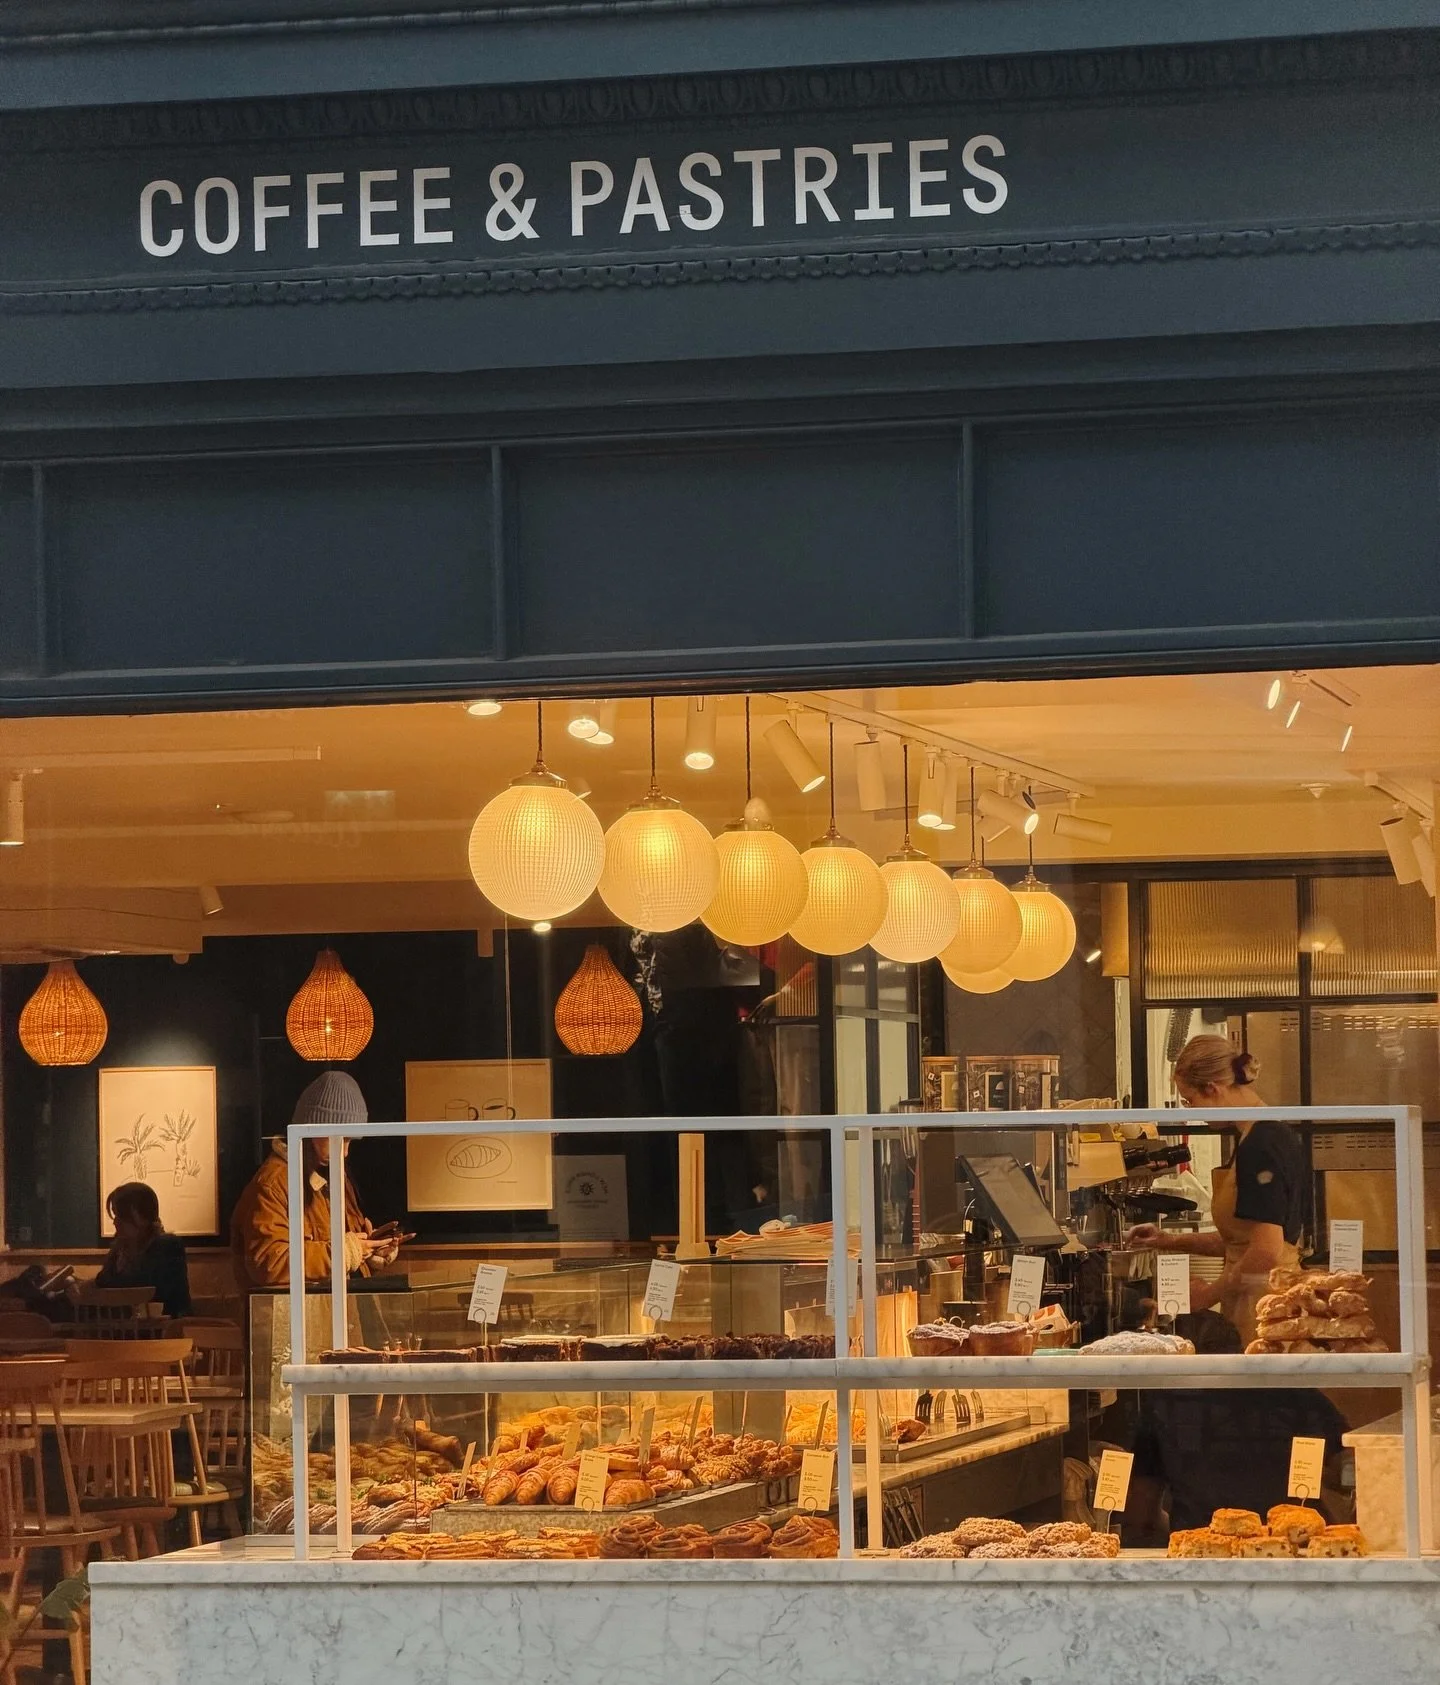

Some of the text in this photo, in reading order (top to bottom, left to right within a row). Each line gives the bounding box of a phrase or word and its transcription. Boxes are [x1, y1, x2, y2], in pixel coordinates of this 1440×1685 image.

[140, 135, 1008, 257] COFFEE & PASTRIES
